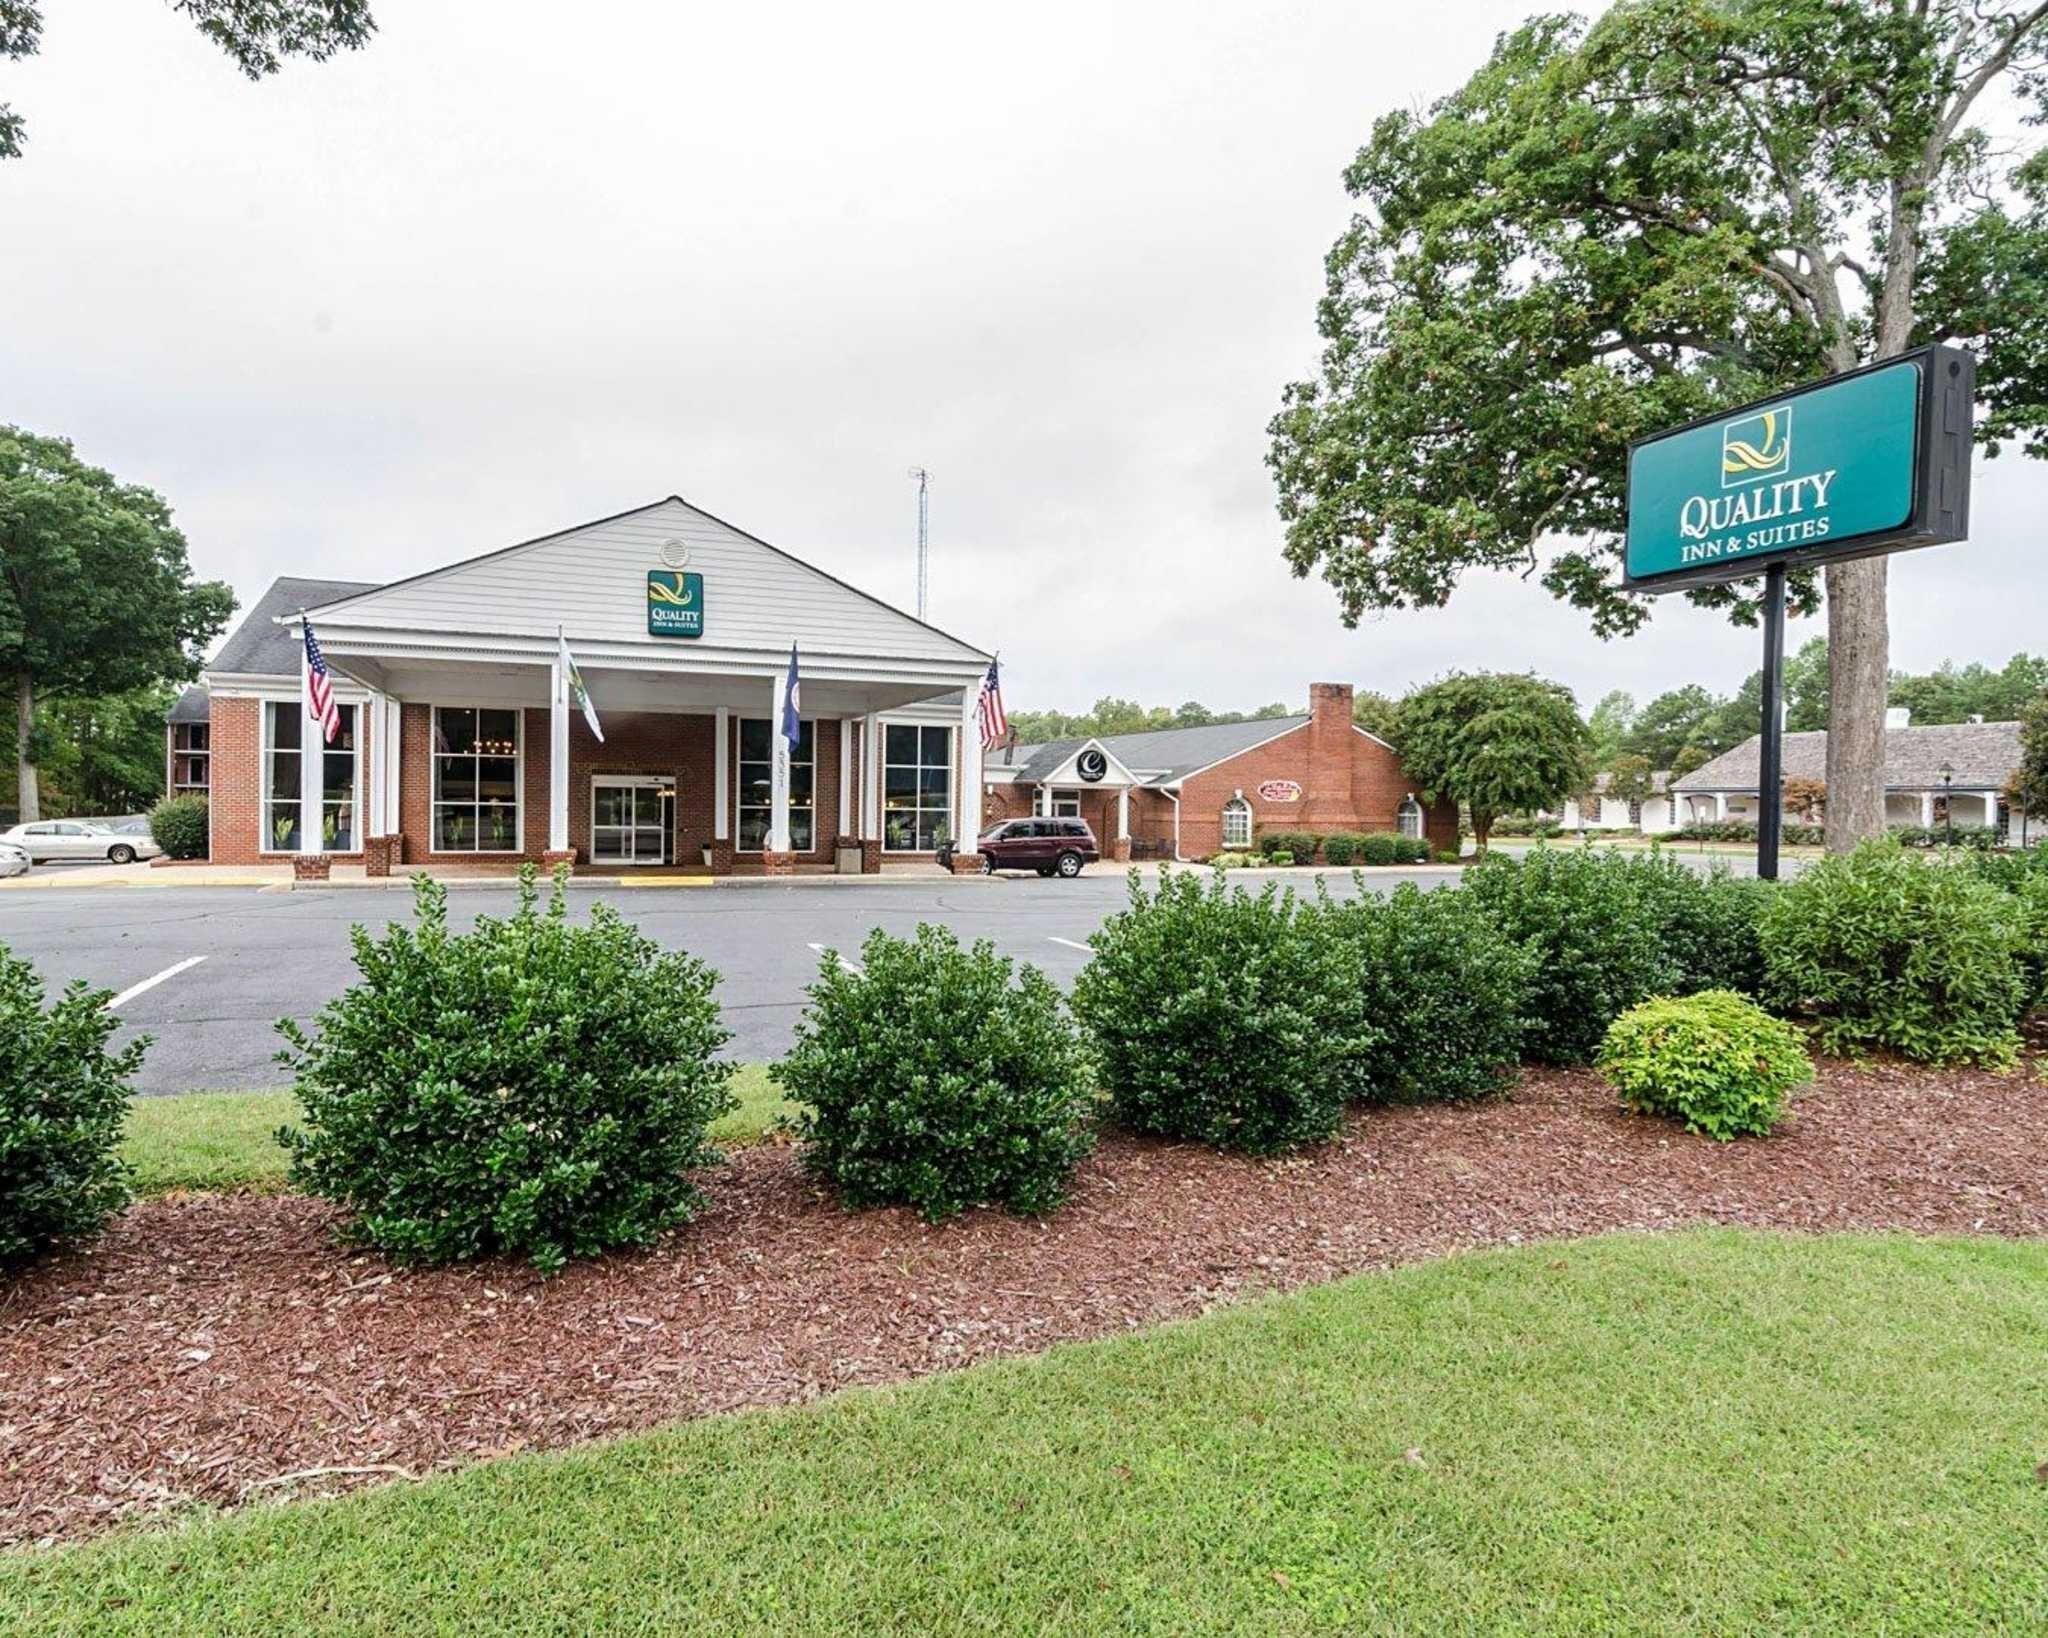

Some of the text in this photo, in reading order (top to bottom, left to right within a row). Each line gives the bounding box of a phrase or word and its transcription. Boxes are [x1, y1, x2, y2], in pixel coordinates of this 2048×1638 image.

[1680, 470, 1837, 539] QUALITY
[1681, 516, 1830, 562] INN & SUITES
[652, 607, 699, 621] QUALITY
